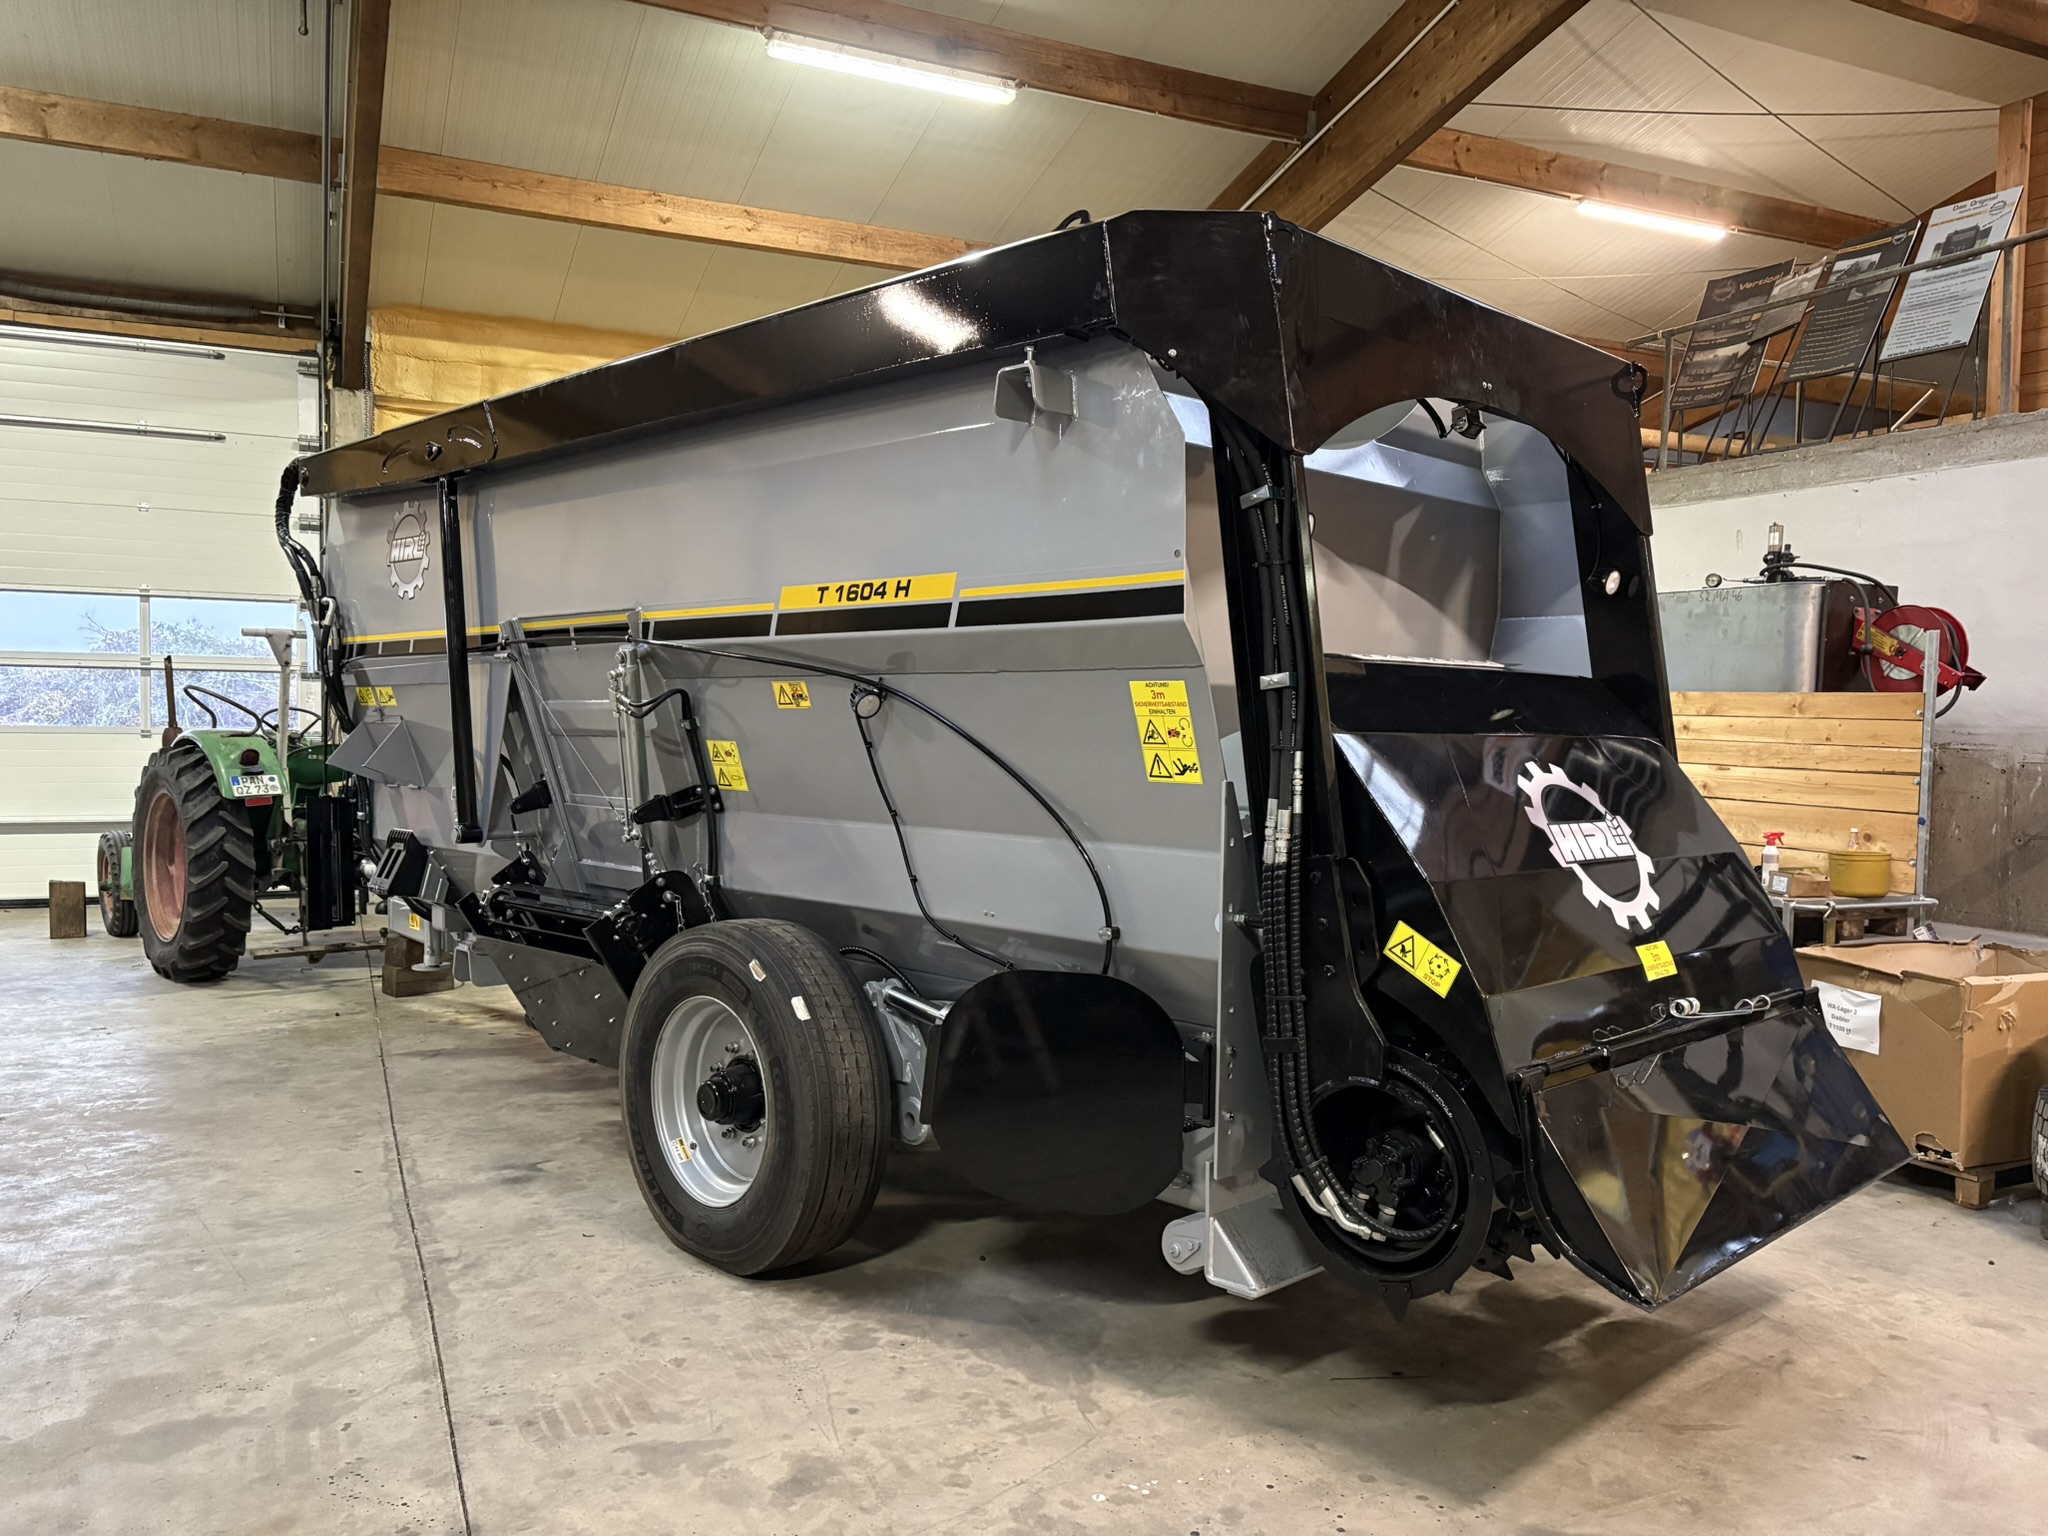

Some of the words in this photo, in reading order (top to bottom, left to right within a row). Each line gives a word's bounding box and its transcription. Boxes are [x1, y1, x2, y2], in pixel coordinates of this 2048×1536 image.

[1970, 194, 1999, 207] Original
[817, 586, 830, 604] T
[835, 581, 888, 602] 1604
[894, 579, 912, 598] H
[1151, 689, 1166, 700] 3m
[241, 776, 265, 785] PAN
[236, 785, 253, 795] QZ
[254, 784, 270, 794] 73
[1548, 820, 1637, 864] HIRL
[1423, 973, 1441, 987] STOP
